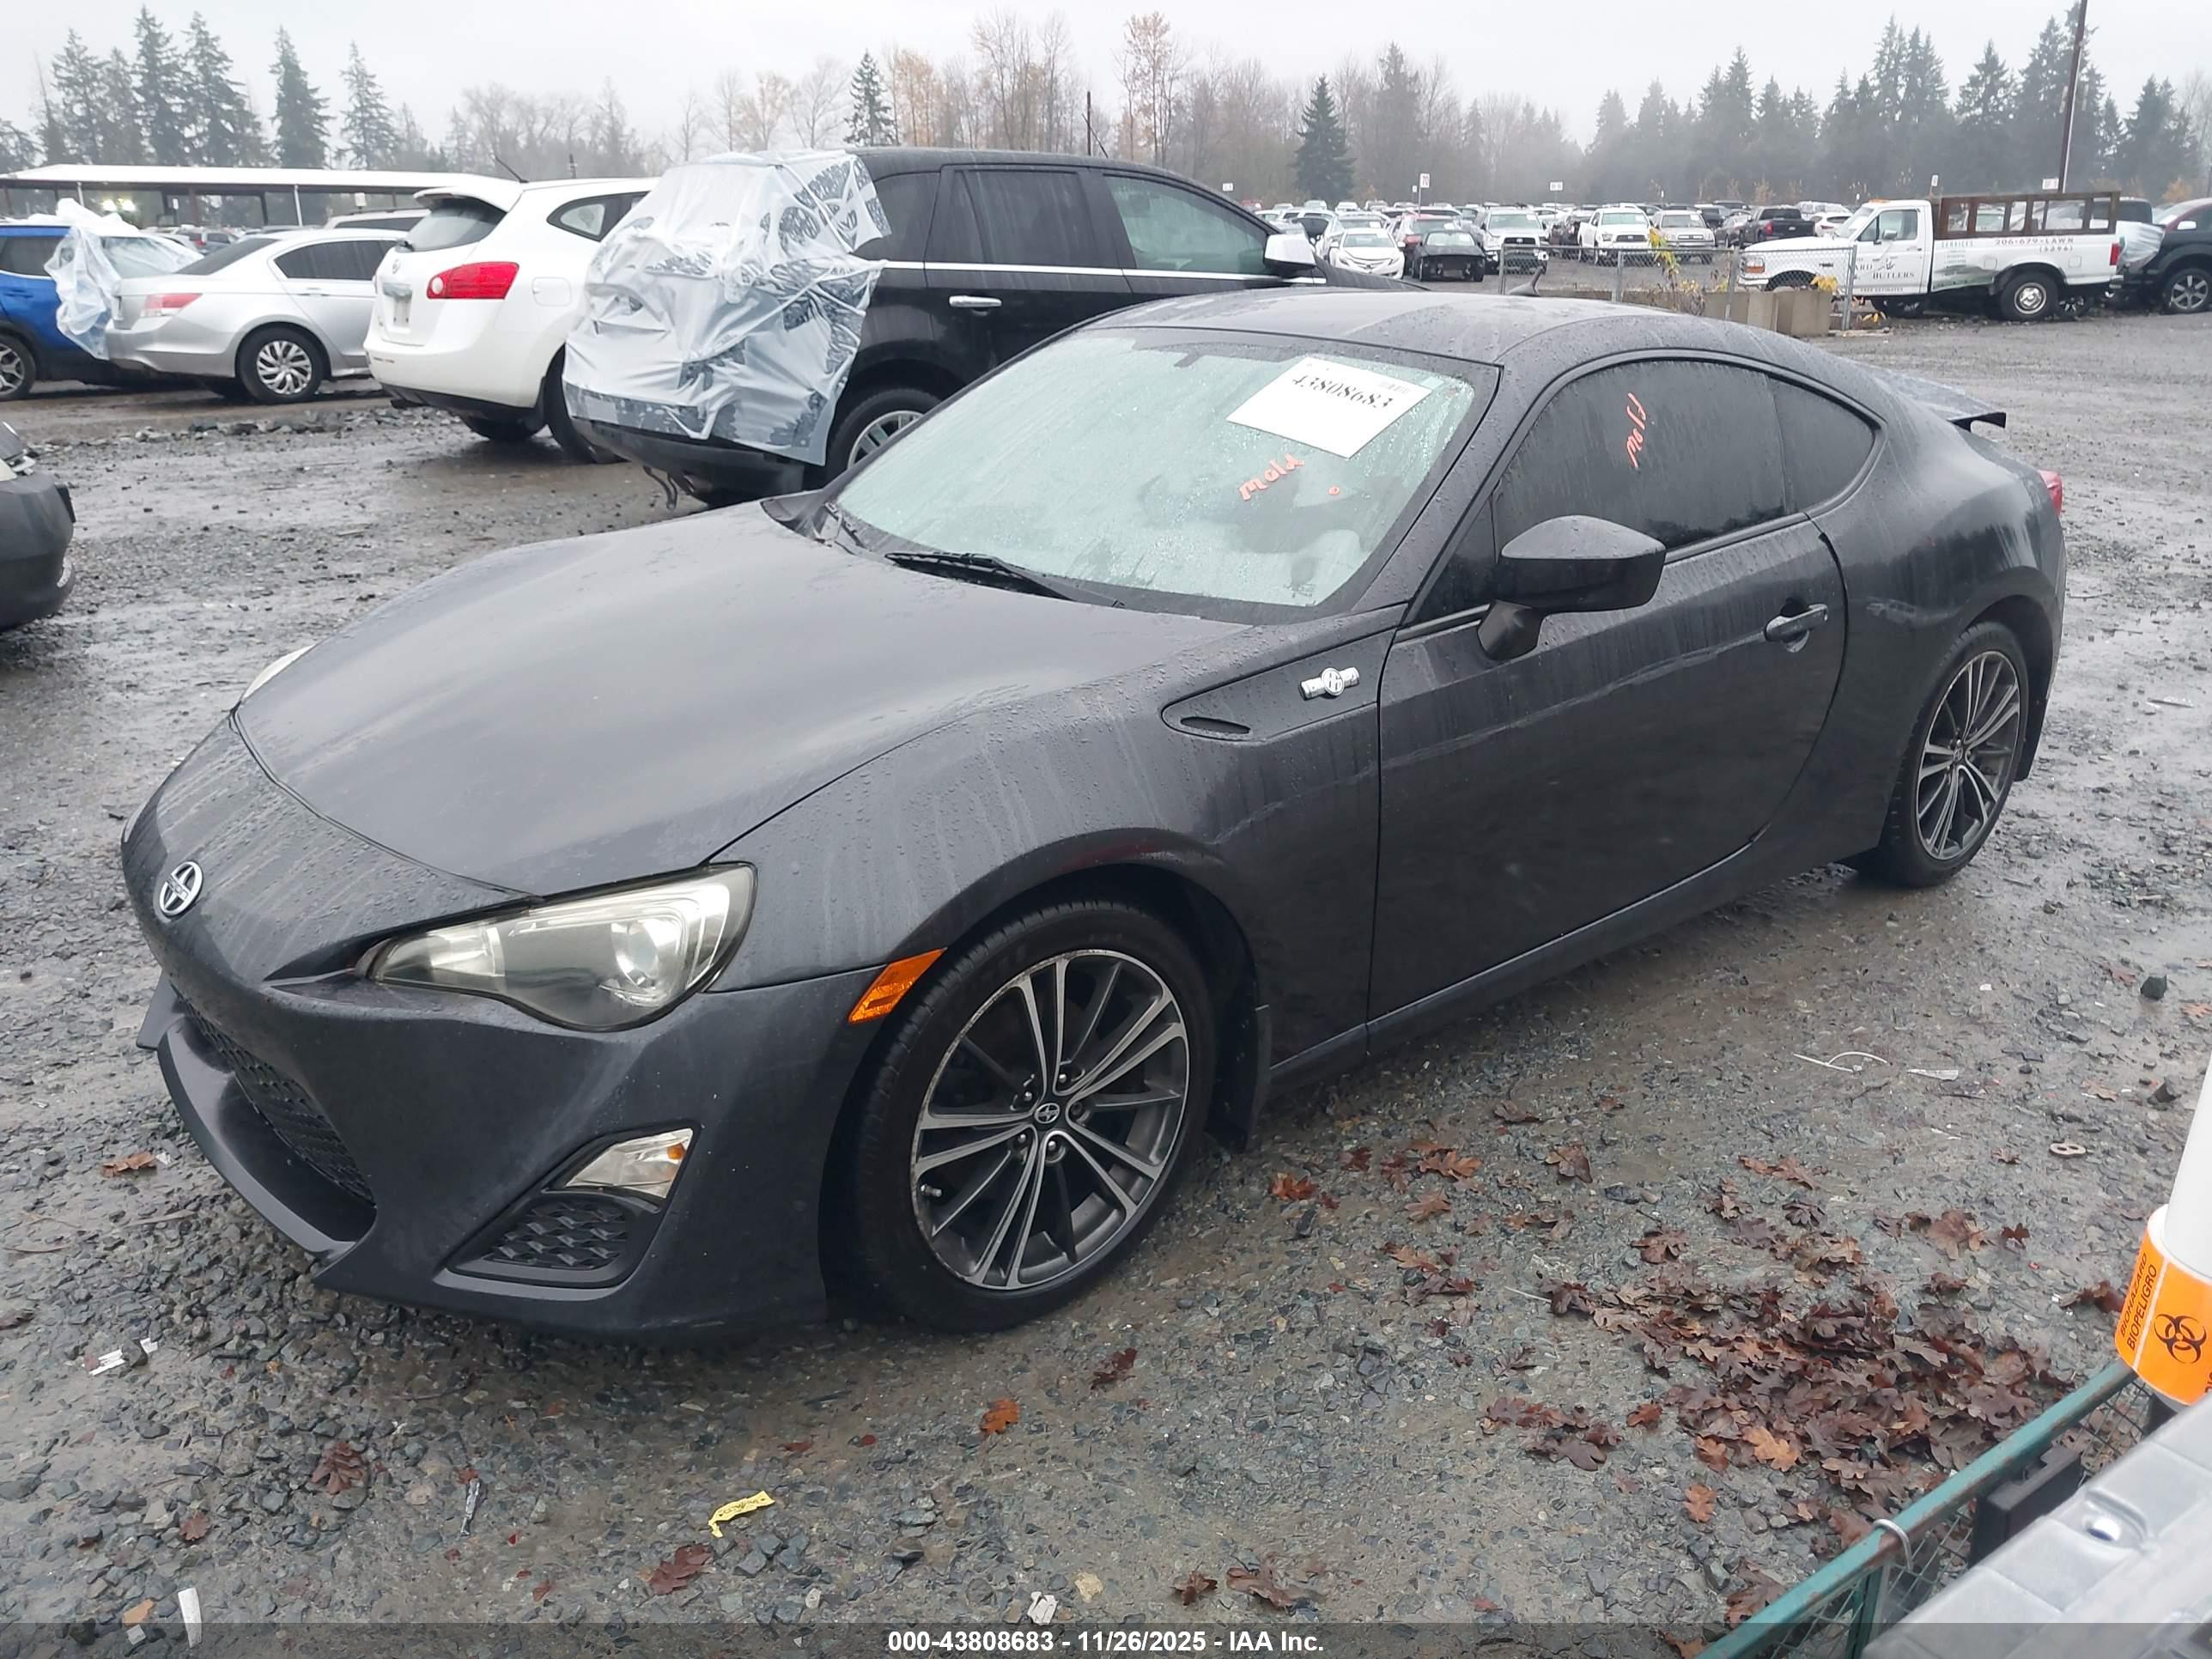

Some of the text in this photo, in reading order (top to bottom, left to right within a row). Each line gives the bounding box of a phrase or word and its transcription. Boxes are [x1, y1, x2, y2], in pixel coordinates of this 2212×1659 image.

[1292, 374, 1394, 409] 43808683
[2120, 1252, 2148, 1338] BIOHAZARD
[2126, 1264, 2157, 1352] BIOPELIGRO
